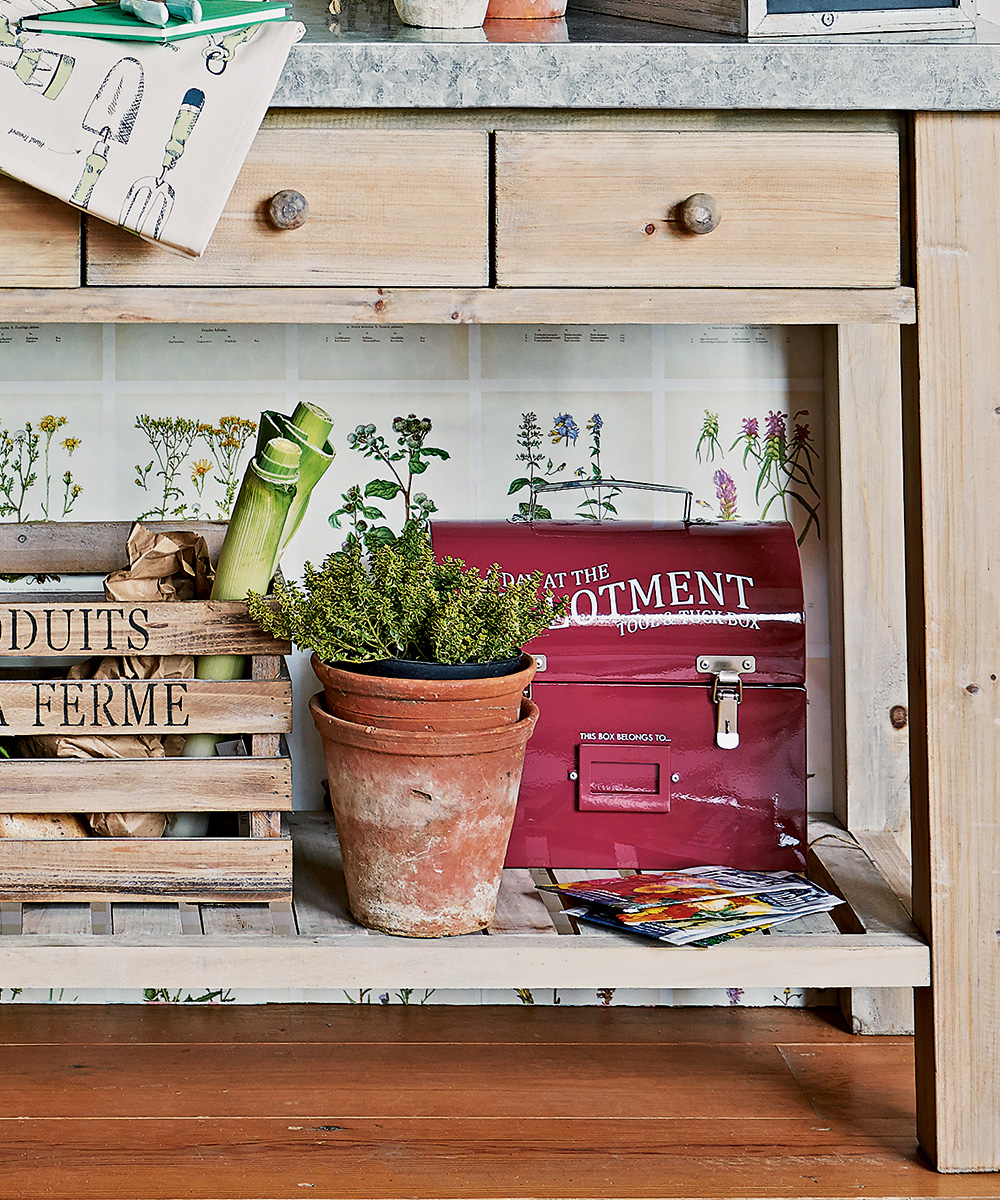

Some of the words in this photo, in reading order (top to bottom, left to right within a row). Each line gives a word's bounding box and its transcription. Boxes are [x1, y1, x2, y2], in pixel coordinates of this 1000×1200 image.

[543, 572, 567, 589] AT
[571, 563, 610, 587] THE
[616, 615, 660, 636] TOOL
[677, 610, 724, 626] TUCK
[725, 612, 761, 630] BOX
[32, 682, 191, 727] FERME
[580, 732, 596, 740] THIS
[598, 732, 615, 740] BOX
[616, 733, 653, 741] BELONGS
